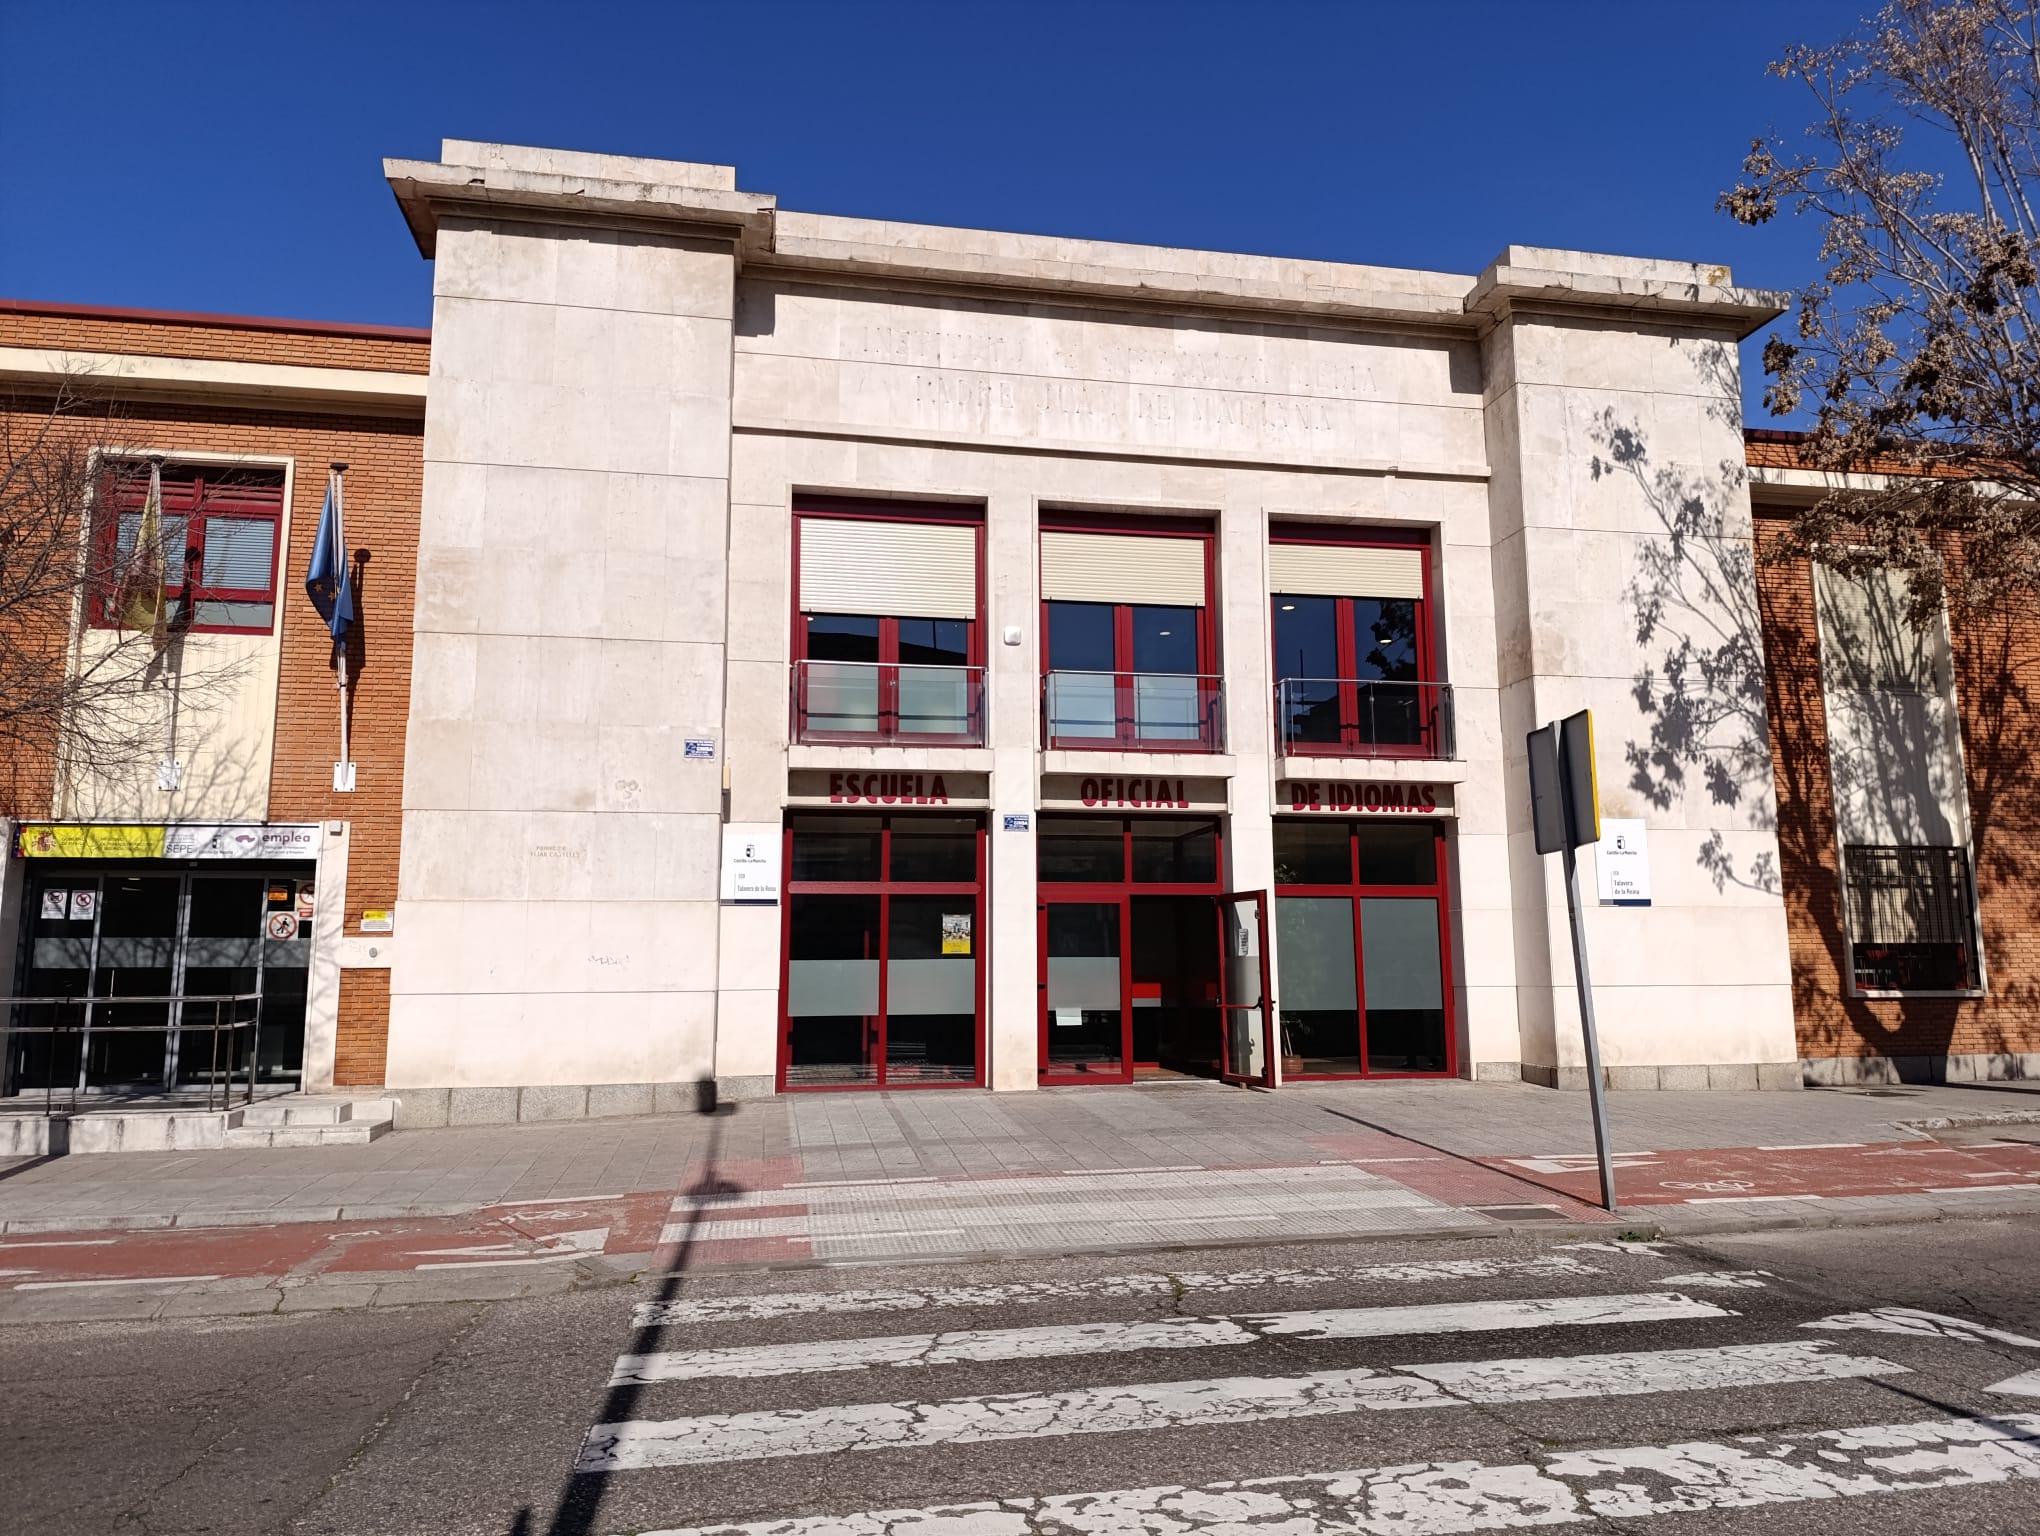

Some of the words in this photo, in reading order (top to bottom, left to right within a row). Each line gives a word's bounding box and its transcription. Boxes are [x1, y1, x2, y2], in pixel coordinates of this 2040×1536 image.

[829, 773, 948, 804] ESCUELA
[1080, 778, 1189, 808] OFICIAL
[1291, 783, 1321, 811] DE
[1328, 783, 1436, 813] IDIOMAS
[166, 844, 193, 854] SEPE
[262, 831, 311, 846] emplea
